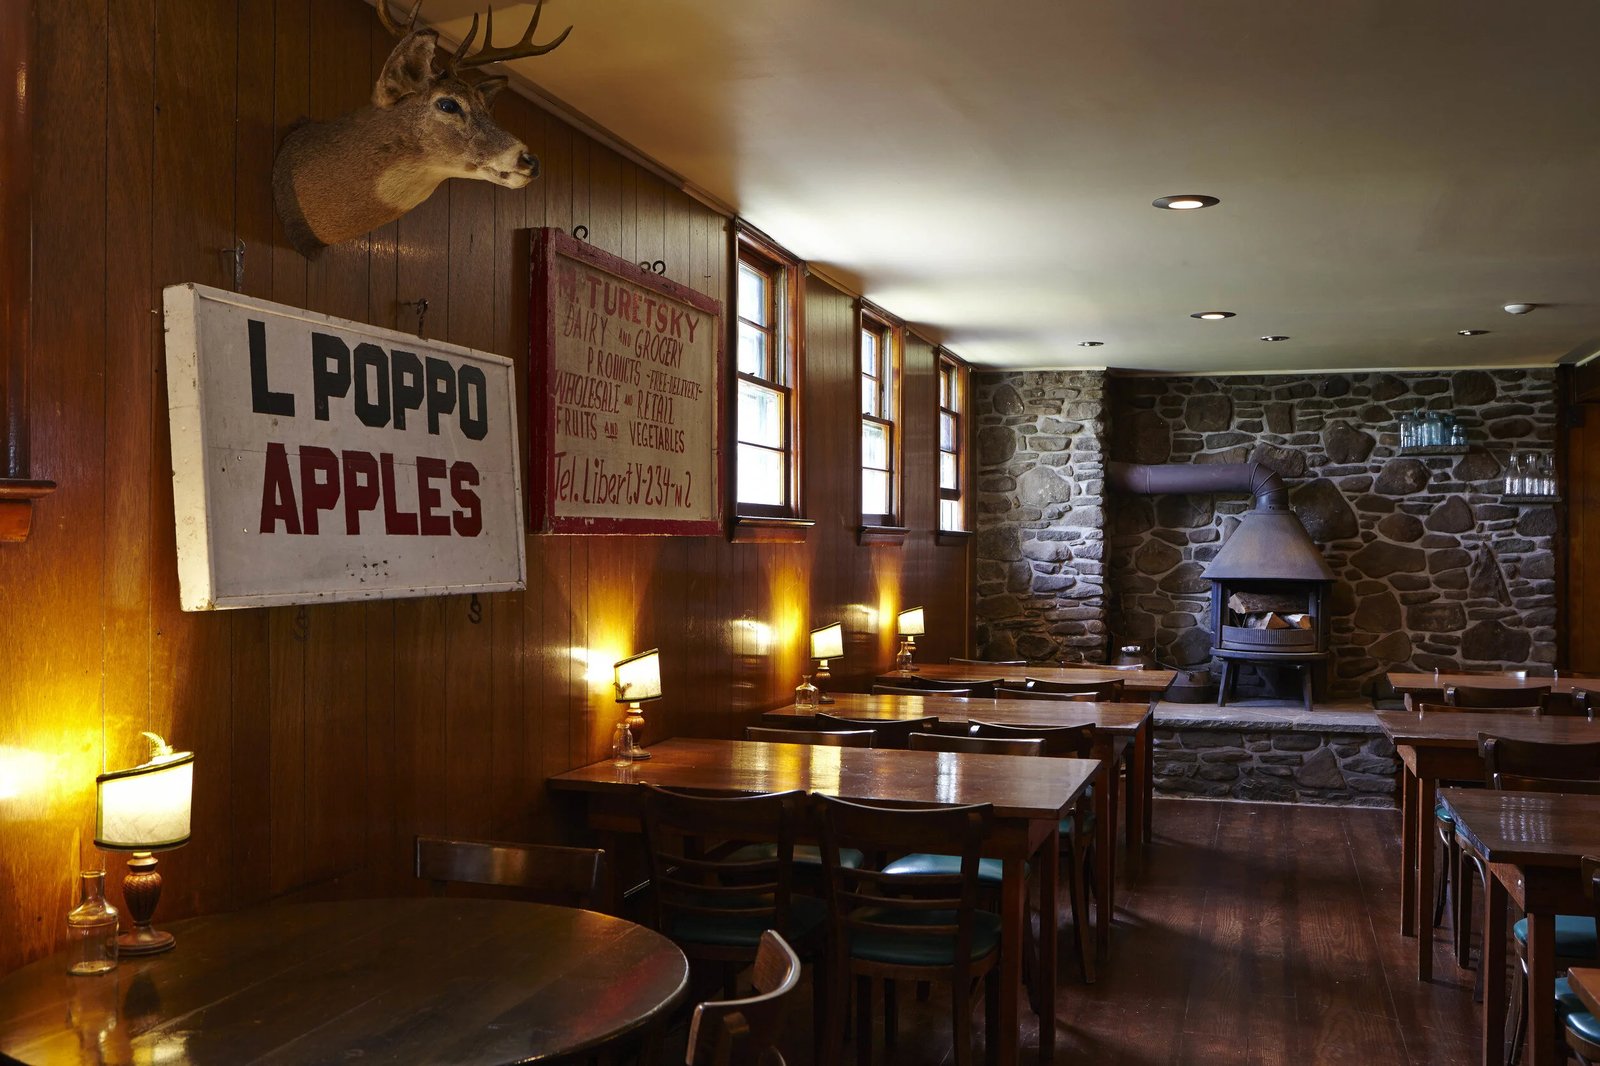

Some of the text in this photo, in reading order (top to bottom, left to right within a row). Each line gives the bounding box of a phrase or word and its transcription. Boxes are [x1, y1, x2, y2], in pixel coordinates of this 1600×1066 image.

[564, 304, 608, 347] DAIRY
[635, 329, 683, 369] GROCERY
[586, 274, 699, 343] TURETSKY
[247, 319, 488, 441] L POPPO
[587, 347, 641, 386] PRODUCTS
[554, 370, 620, 413] WHOLESALE
[637, 389, 675, 425] RETAIL
[556, 406, 685, 454] FRUITS AND VEGETABLES
[259, 442, 483, 537] APPLES
[555, 452, 579, 501] Tel.
